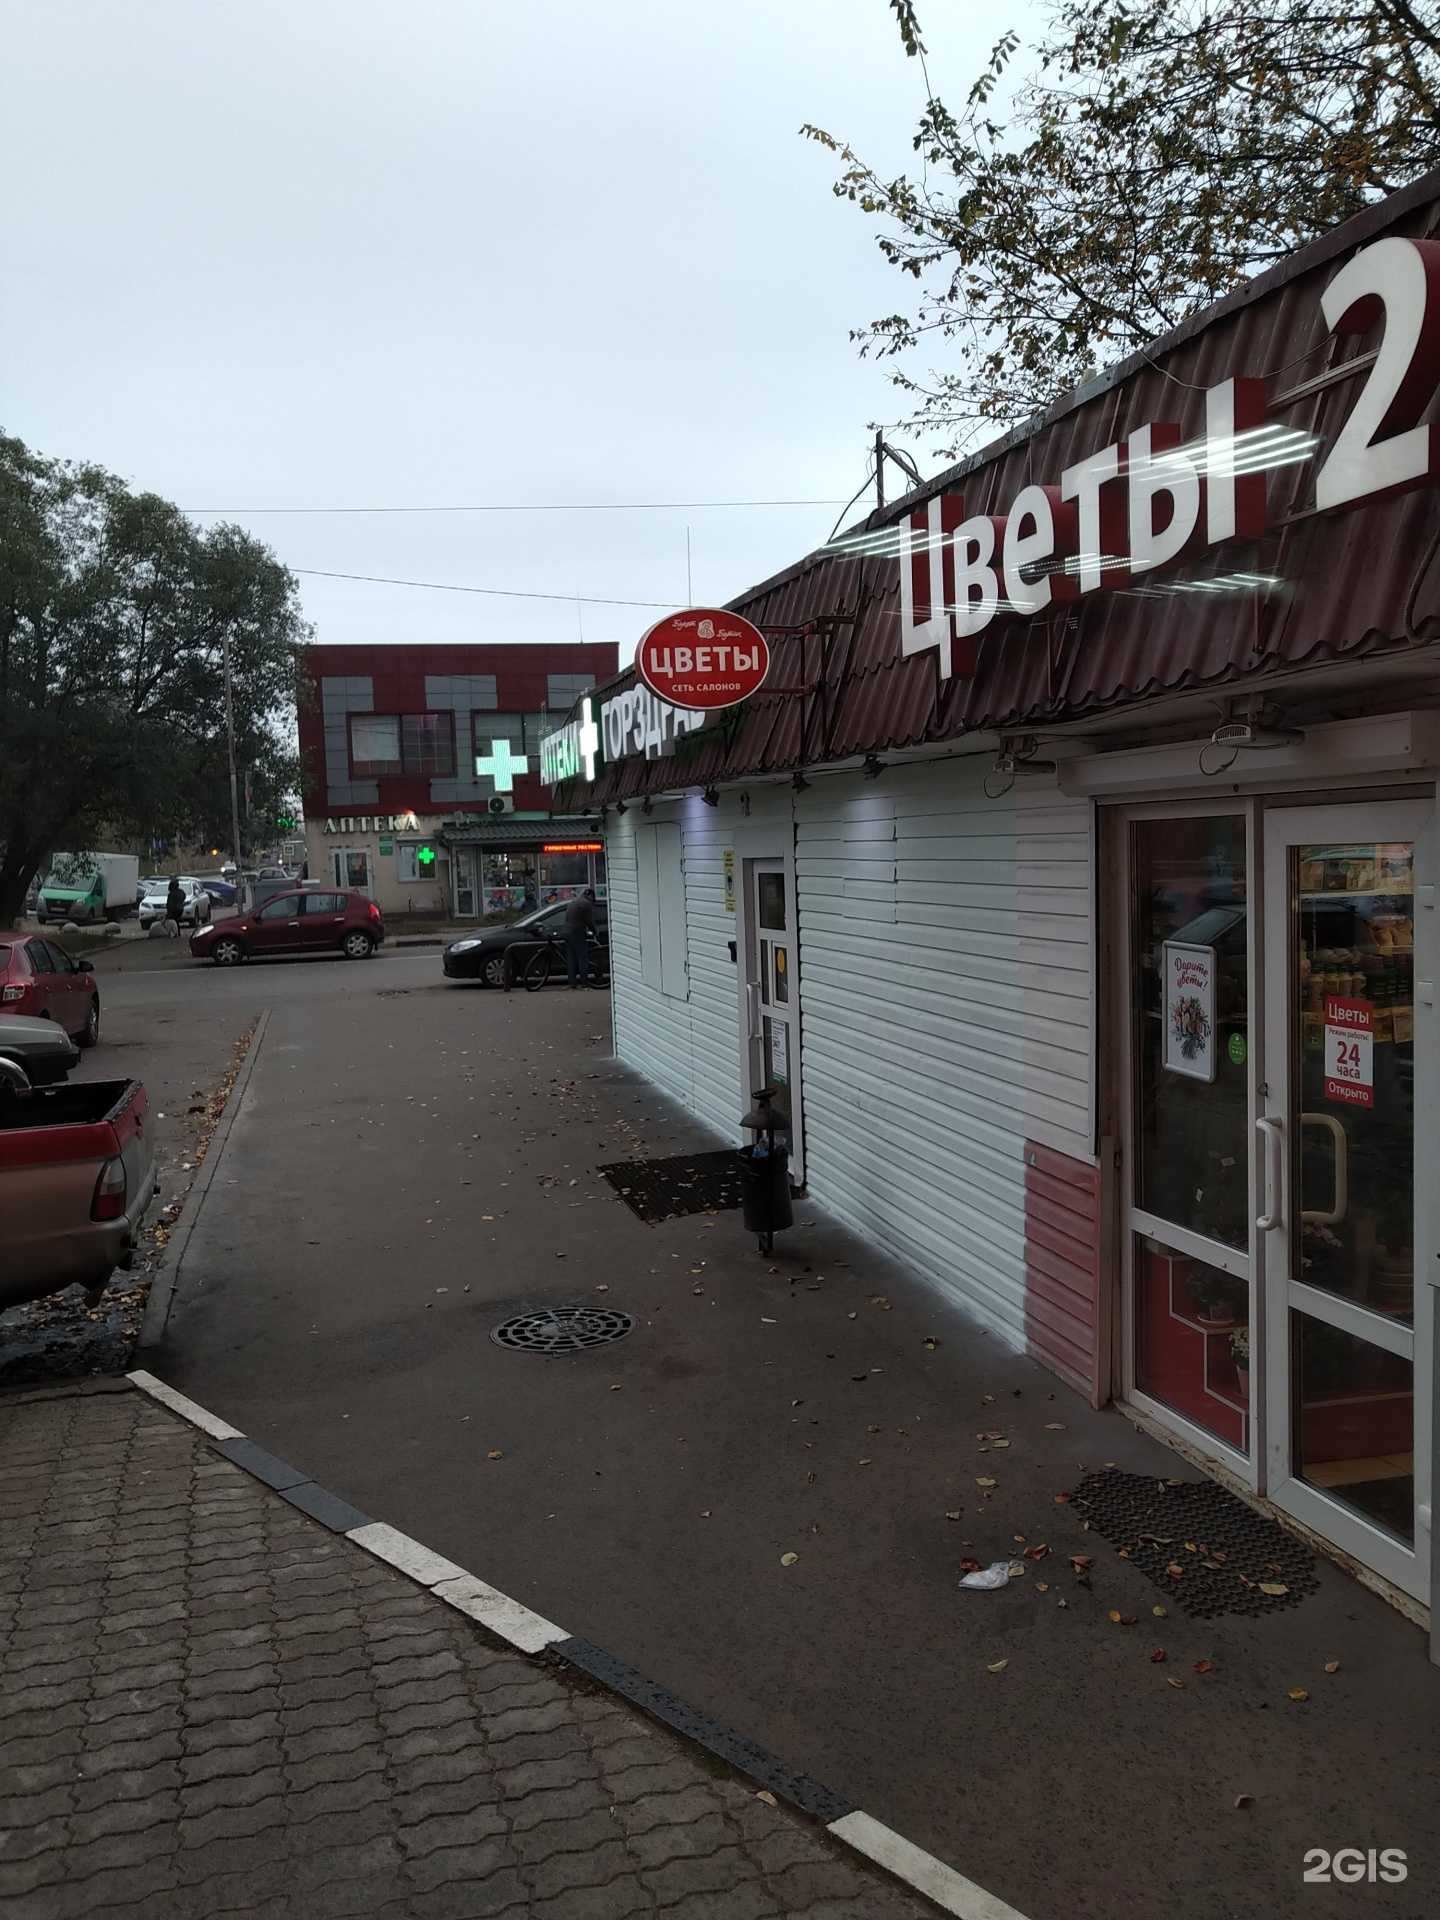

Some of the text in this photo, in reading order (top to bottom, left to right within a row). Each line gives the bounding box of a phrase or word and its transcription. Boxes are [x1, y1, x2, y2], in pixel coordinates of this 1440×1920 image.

[899, 236, 1432, 680] Цветы 2
[650, 646, 759, 678] ЦВЕТЫ
[672, 682, 741, 693] СЕТЬ САЛОНОВ
[600, 683, 705, 762] ГОРЗДР
[324, 815, 420, 833] АПТЕКА
[1174, 956, 1209, 978] Дарите
[1328, 1003, 1369, 1024] Цветы
[1336, 1040, 1361, 1067] 24
[1336, 1064, 1361, 1080] часа
[1328, 1081, 1369, 1101] Открыто
